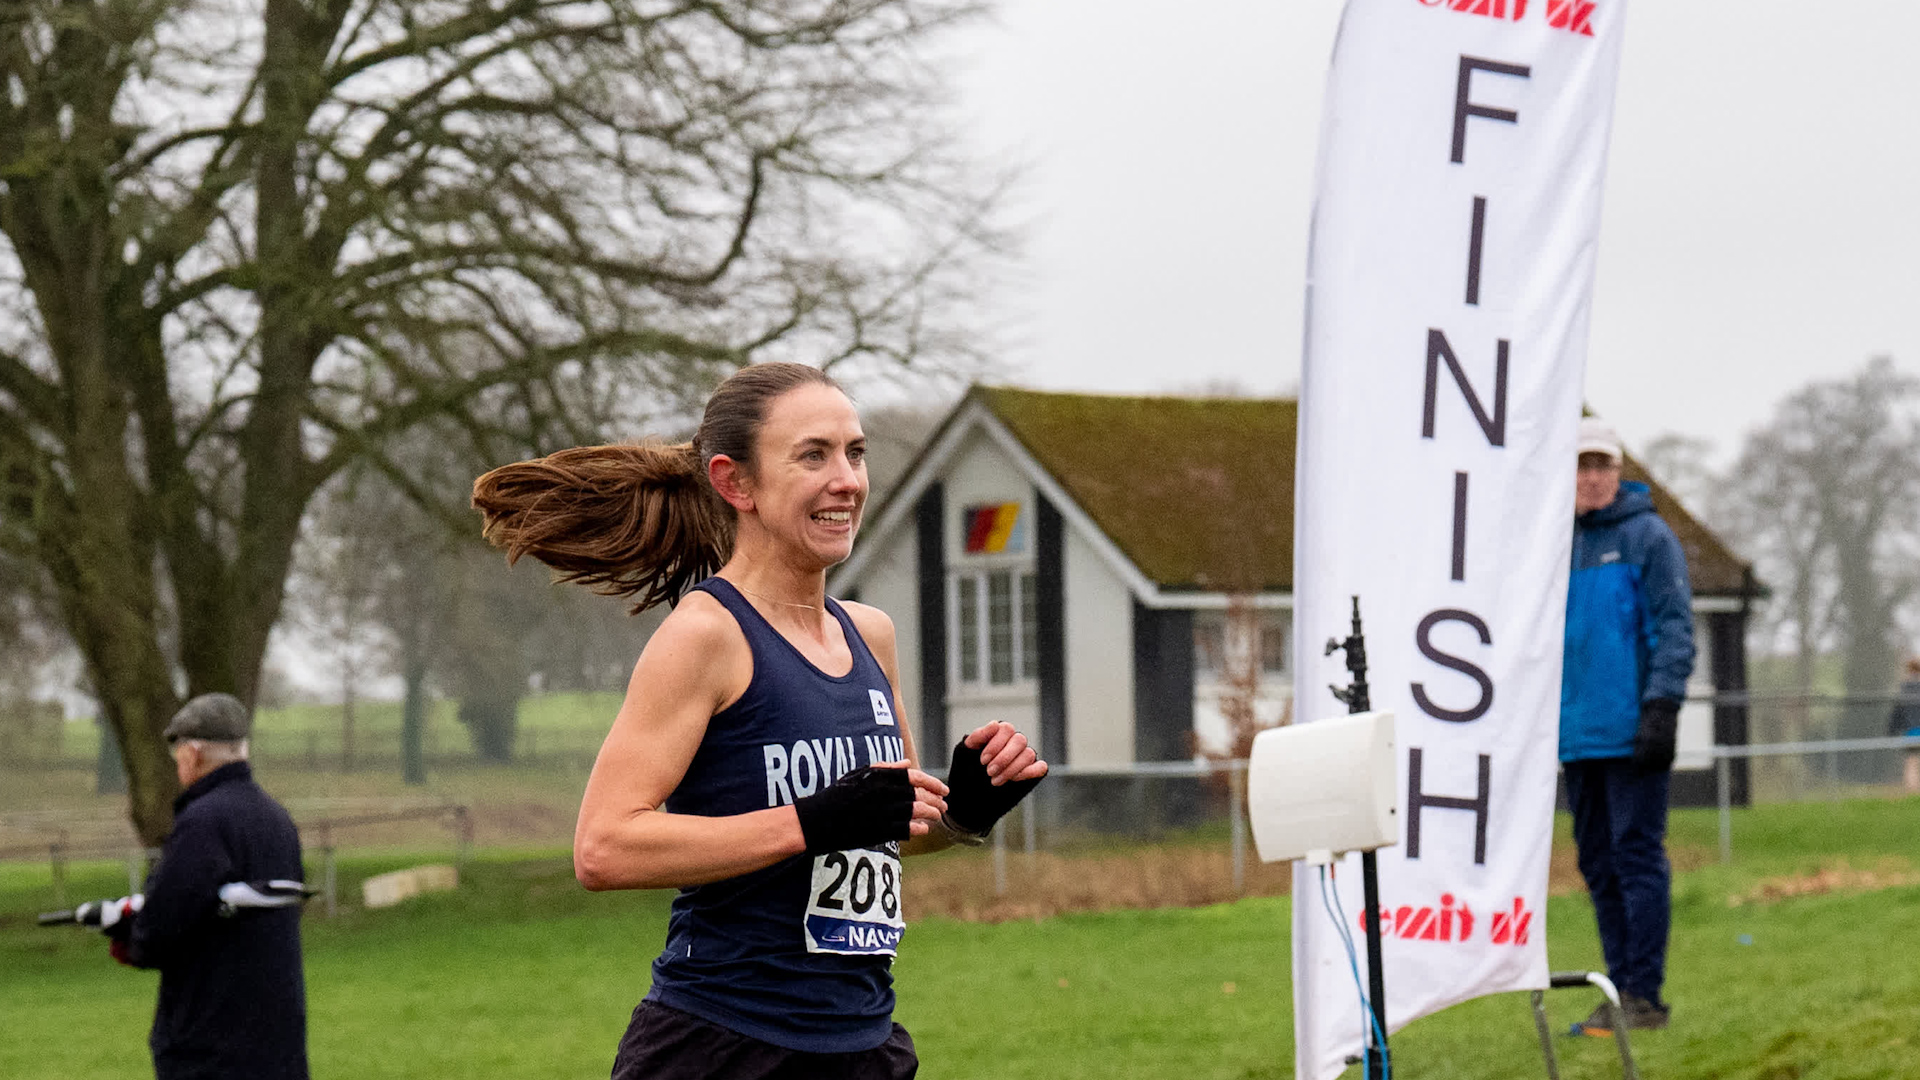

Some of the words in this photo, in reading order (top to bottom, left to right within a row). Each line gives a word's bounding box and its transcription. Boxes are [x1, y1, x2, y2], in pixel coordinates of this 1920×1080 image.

[1406, 55, 1531, 865] FINISH
[816, 851, 902, 919] 208
[1490, 896, 1533, 946] uk
